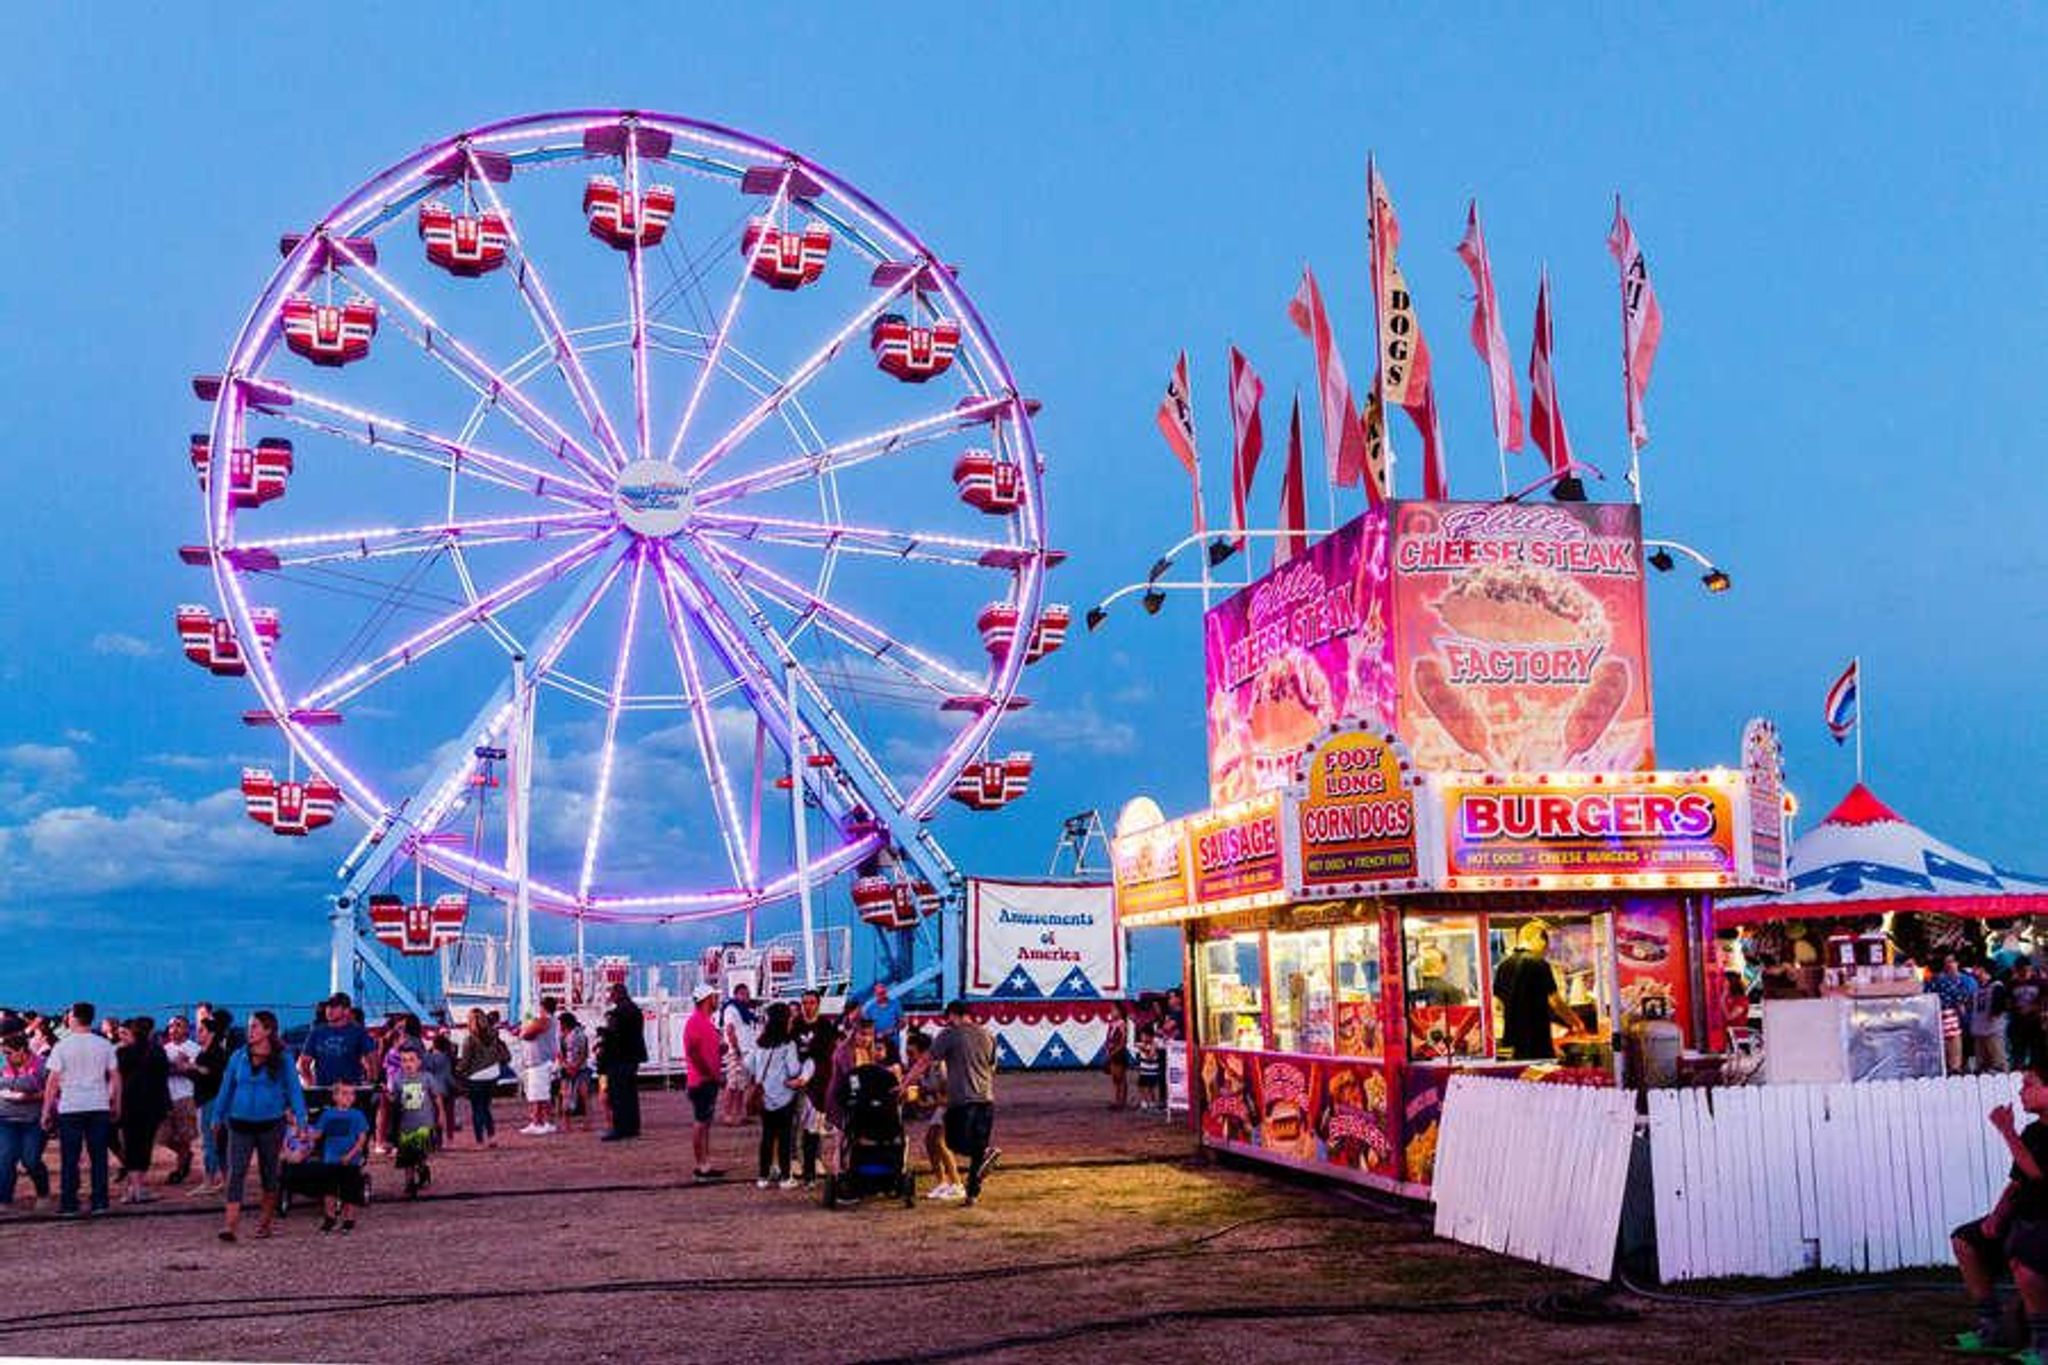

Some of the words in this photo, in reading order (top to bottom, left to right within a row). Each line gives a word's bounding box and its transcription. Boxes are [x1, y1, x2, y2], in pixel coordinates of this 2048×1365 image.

[1388, 289, 1410, 386] DOGS
[1398, 538, 1524, 573] CHEESE
[1529, 540, 1638, 577] STEAK
[1226, 615, 1290, 691] CHEESE
[1291, 582, 1358, 650] STEAK
[1449, 646, 1603, 684] FACTORY
[1325, 747, 1384, 773] FOOT
[1325, 773, 1387, 798] LONG
[1305, 805, 1356, 846] CORN
[1357, 799, 1413, 841] DOGS
[1462, 793, 1716, 842] BURGERS
[1199, 816, 1278, 873] SAUSAGE
[999, 909, 1094, 926] Amusements
[1017, 946, 1082, 962] America
[1040, 930, 1055, 945] of
